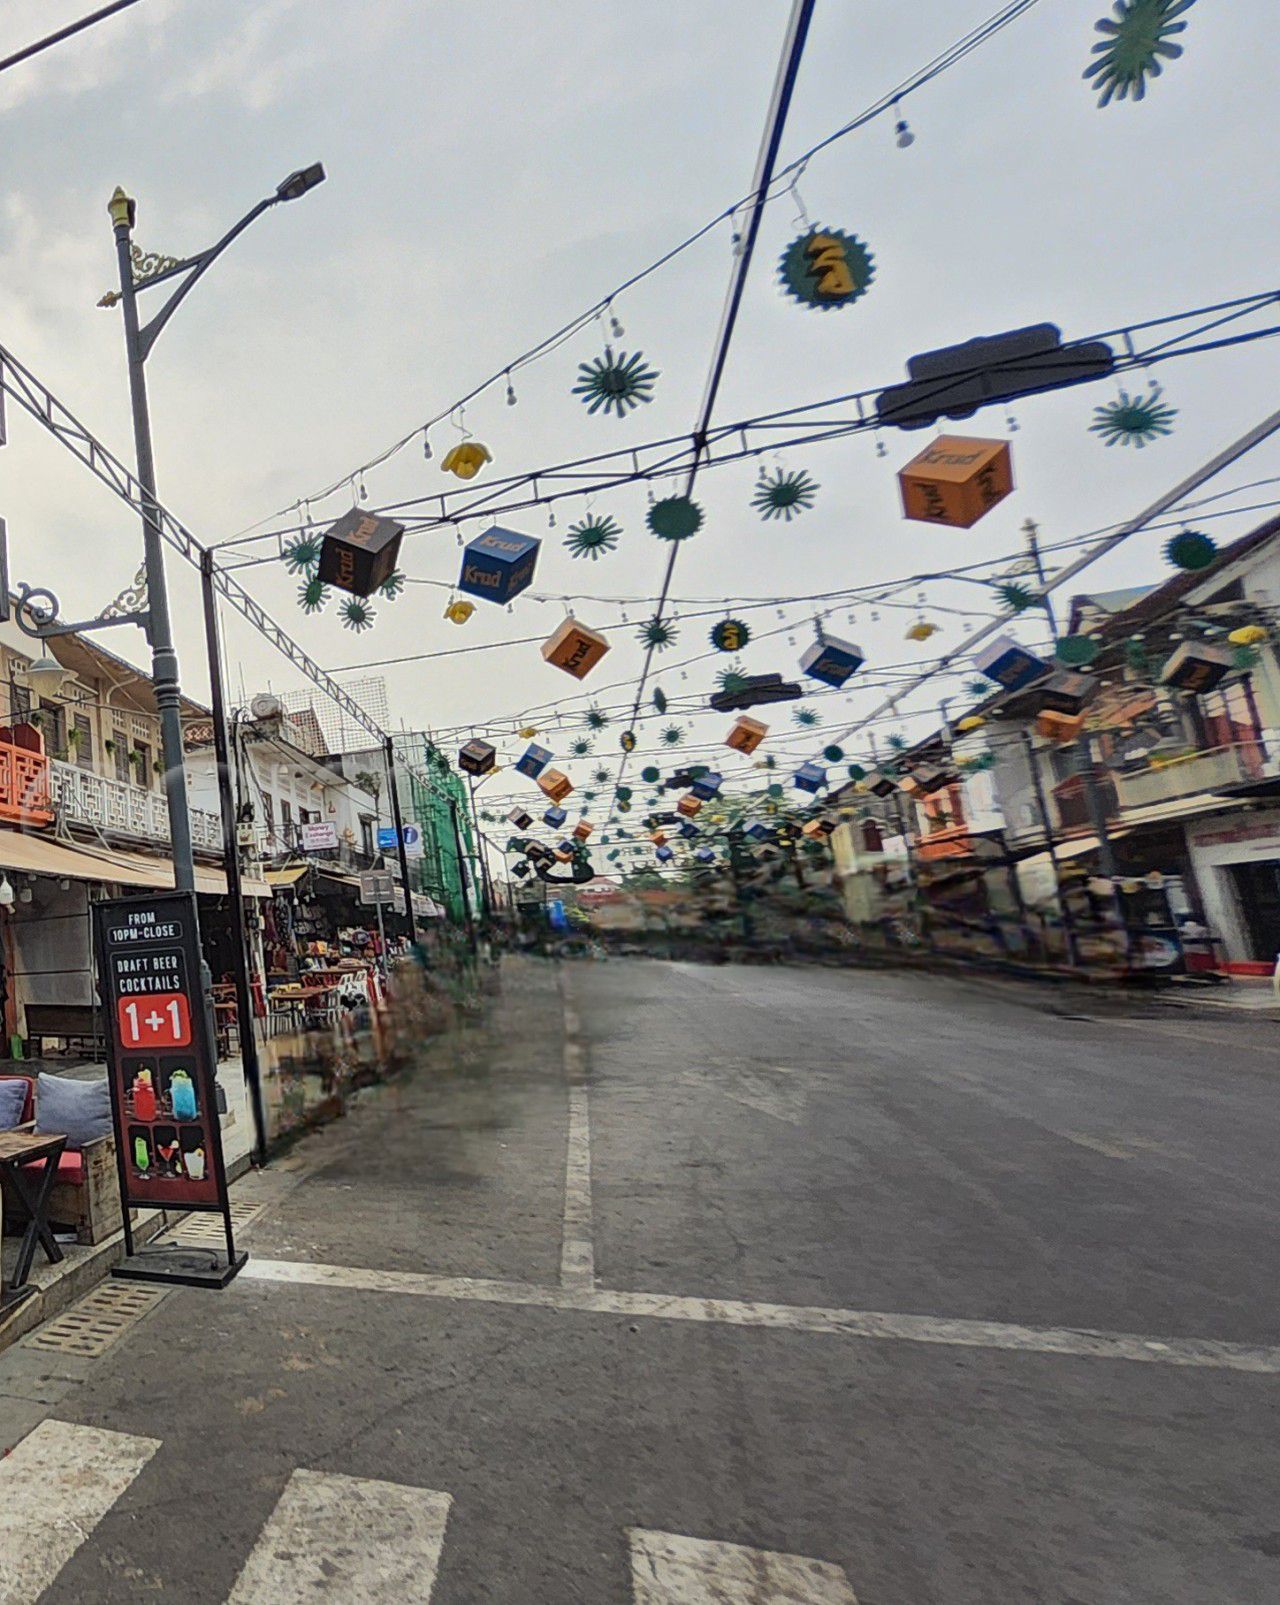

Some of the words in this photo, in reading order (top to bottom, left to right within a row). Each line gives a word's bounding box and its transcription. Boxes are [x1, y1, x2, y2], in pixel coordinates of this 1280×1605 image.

[464, 565, 503, 588] Krud
[128, 911, 156, 926] FROM
[112, 924, 175, 942] 10PM-CLOSE
[117, 957, 148, 973] DRAFT
[153, 956, 178, 971] BEER
[119, 975, 180, 993] COCKTAILS
[125, 999, 182, 1042] 1+1
